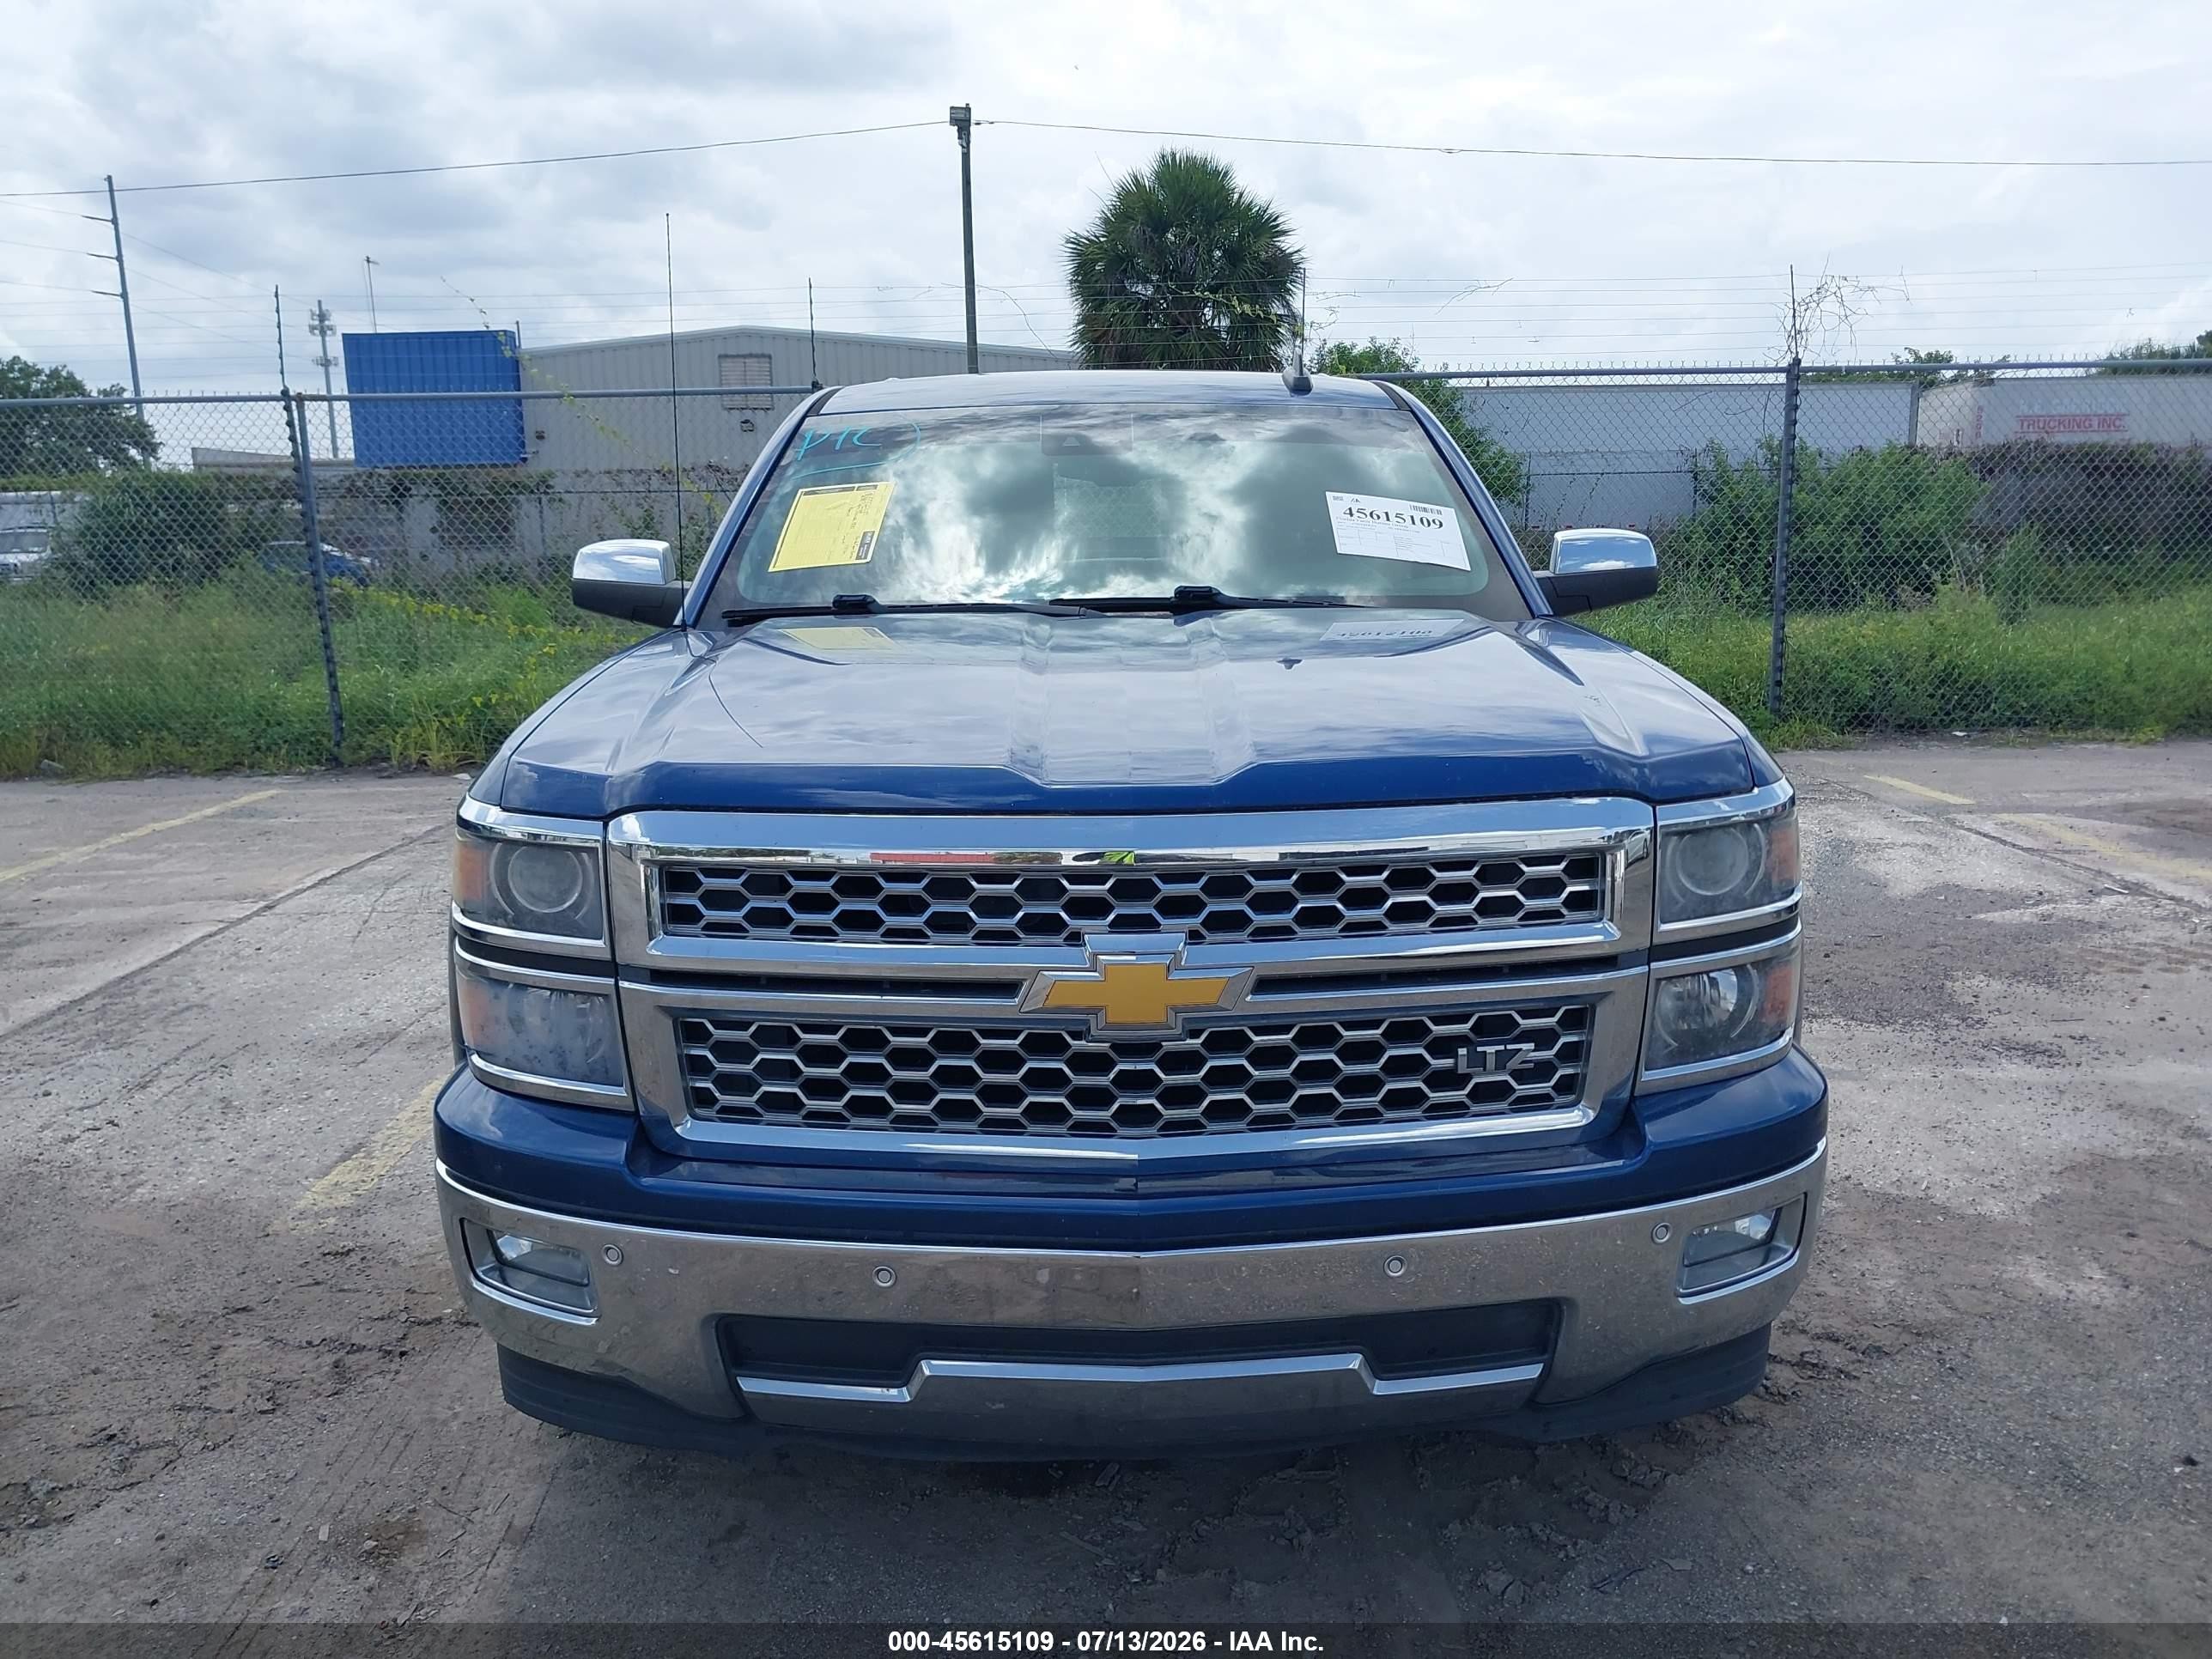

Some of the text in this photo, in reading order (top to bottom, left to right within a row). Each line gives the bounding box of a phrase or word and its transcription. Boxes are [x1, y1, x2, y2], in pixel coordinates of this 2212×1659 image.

[2019, 416, 2125, 430] TRUCKING INC.
[1343, 507, 1443, 530] 45615109
[1457, 1043, 1535, 1074] LTZ
